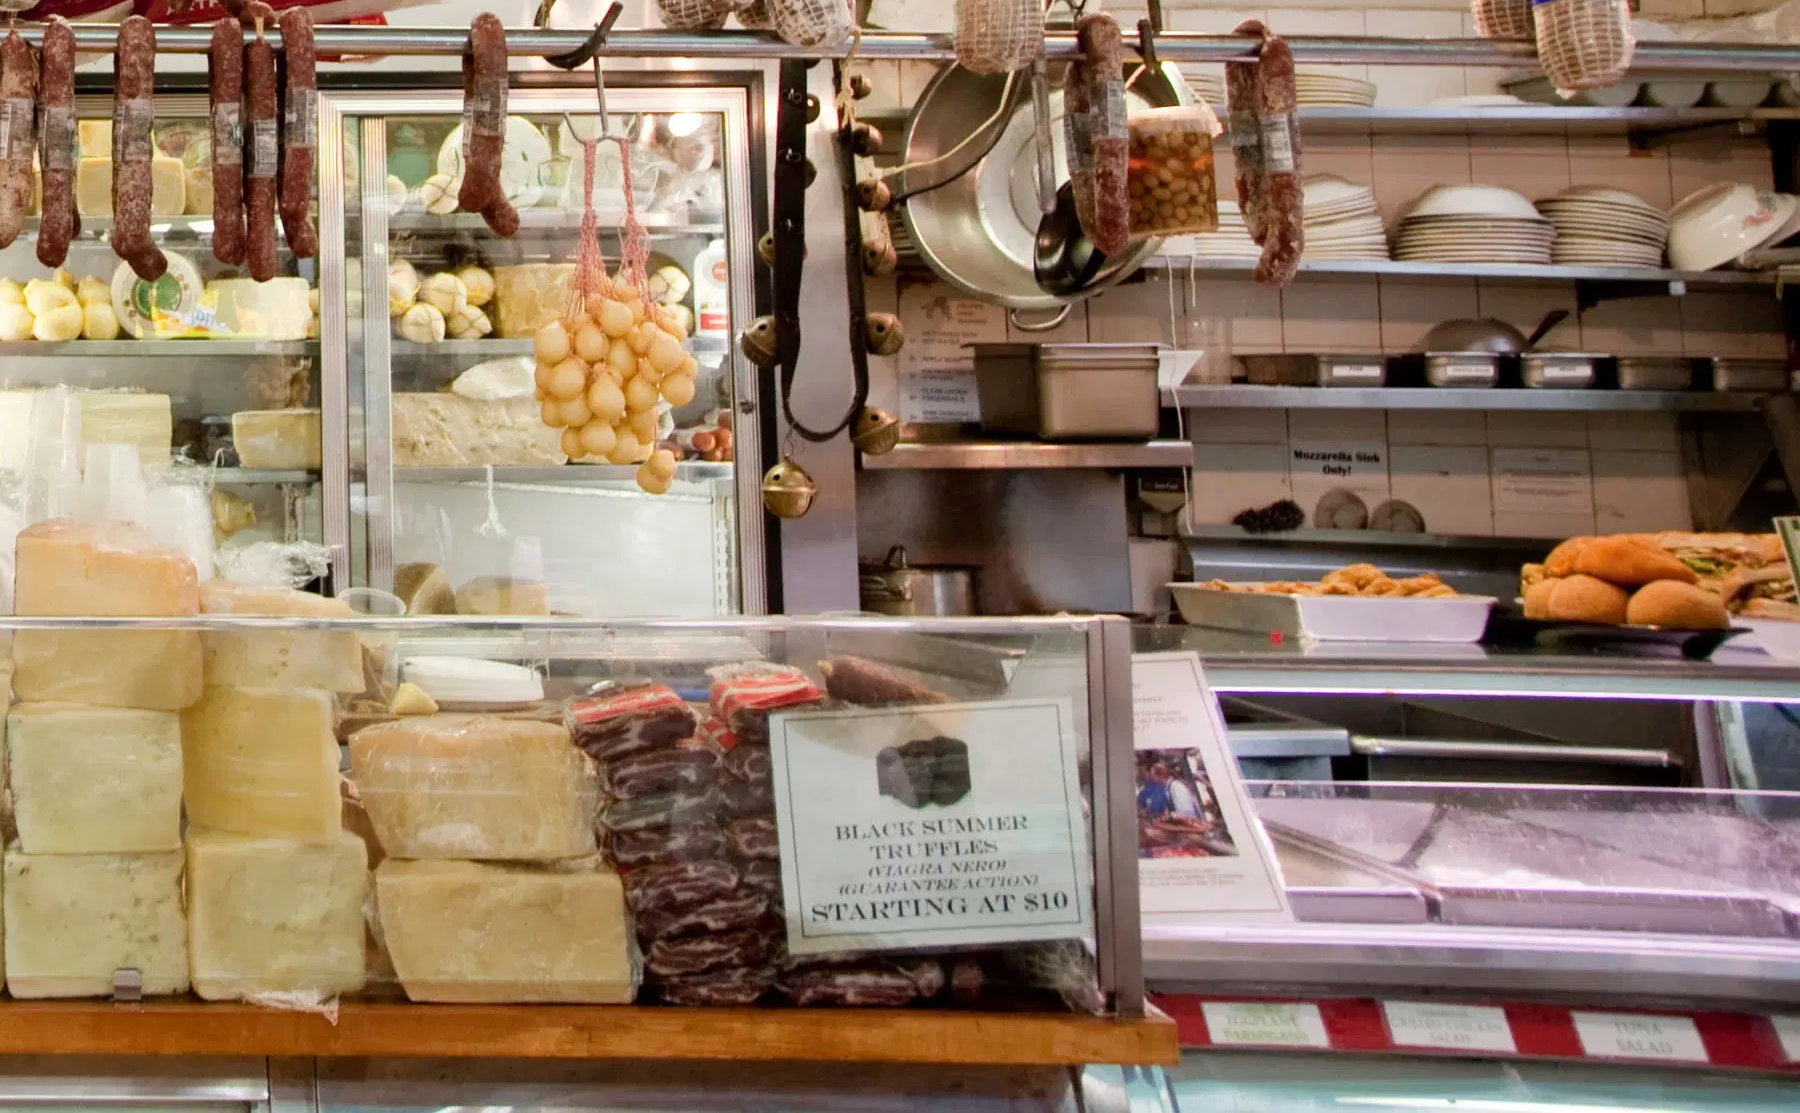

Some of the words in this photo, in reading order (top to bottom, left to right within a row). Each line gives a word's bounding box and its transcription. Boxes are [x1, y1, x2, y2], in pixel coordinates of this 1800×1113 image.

[1293, 449, 1353, 463] Mozzarella
[1355, 451, 1381, 464] Sink
[1322, 464, 1352, 477] Only!
[835, 820, 916, 842] BLACK
[921, 813, 1029, 836] SUMMER
[869, 838, 999, 861] TRUFFLES
[868, 861, 944, 879] (VIAGRA
[951, 858, 1009, 875] NERO)
[839, 877, 961, 897] (GUARANTEE
[966, 873, 1040, 891] ACTION)
[811, 897, 968, 924] STARTING
[977, 893, 1017, 914] AT
[1023, 890, 1069, 913] $10
[1613, 1020, 1664, 1035] TUNA
[1429, 1032, 1472, 1045] SALAD
[1616, 1038, 1674, 1054] SALAD
